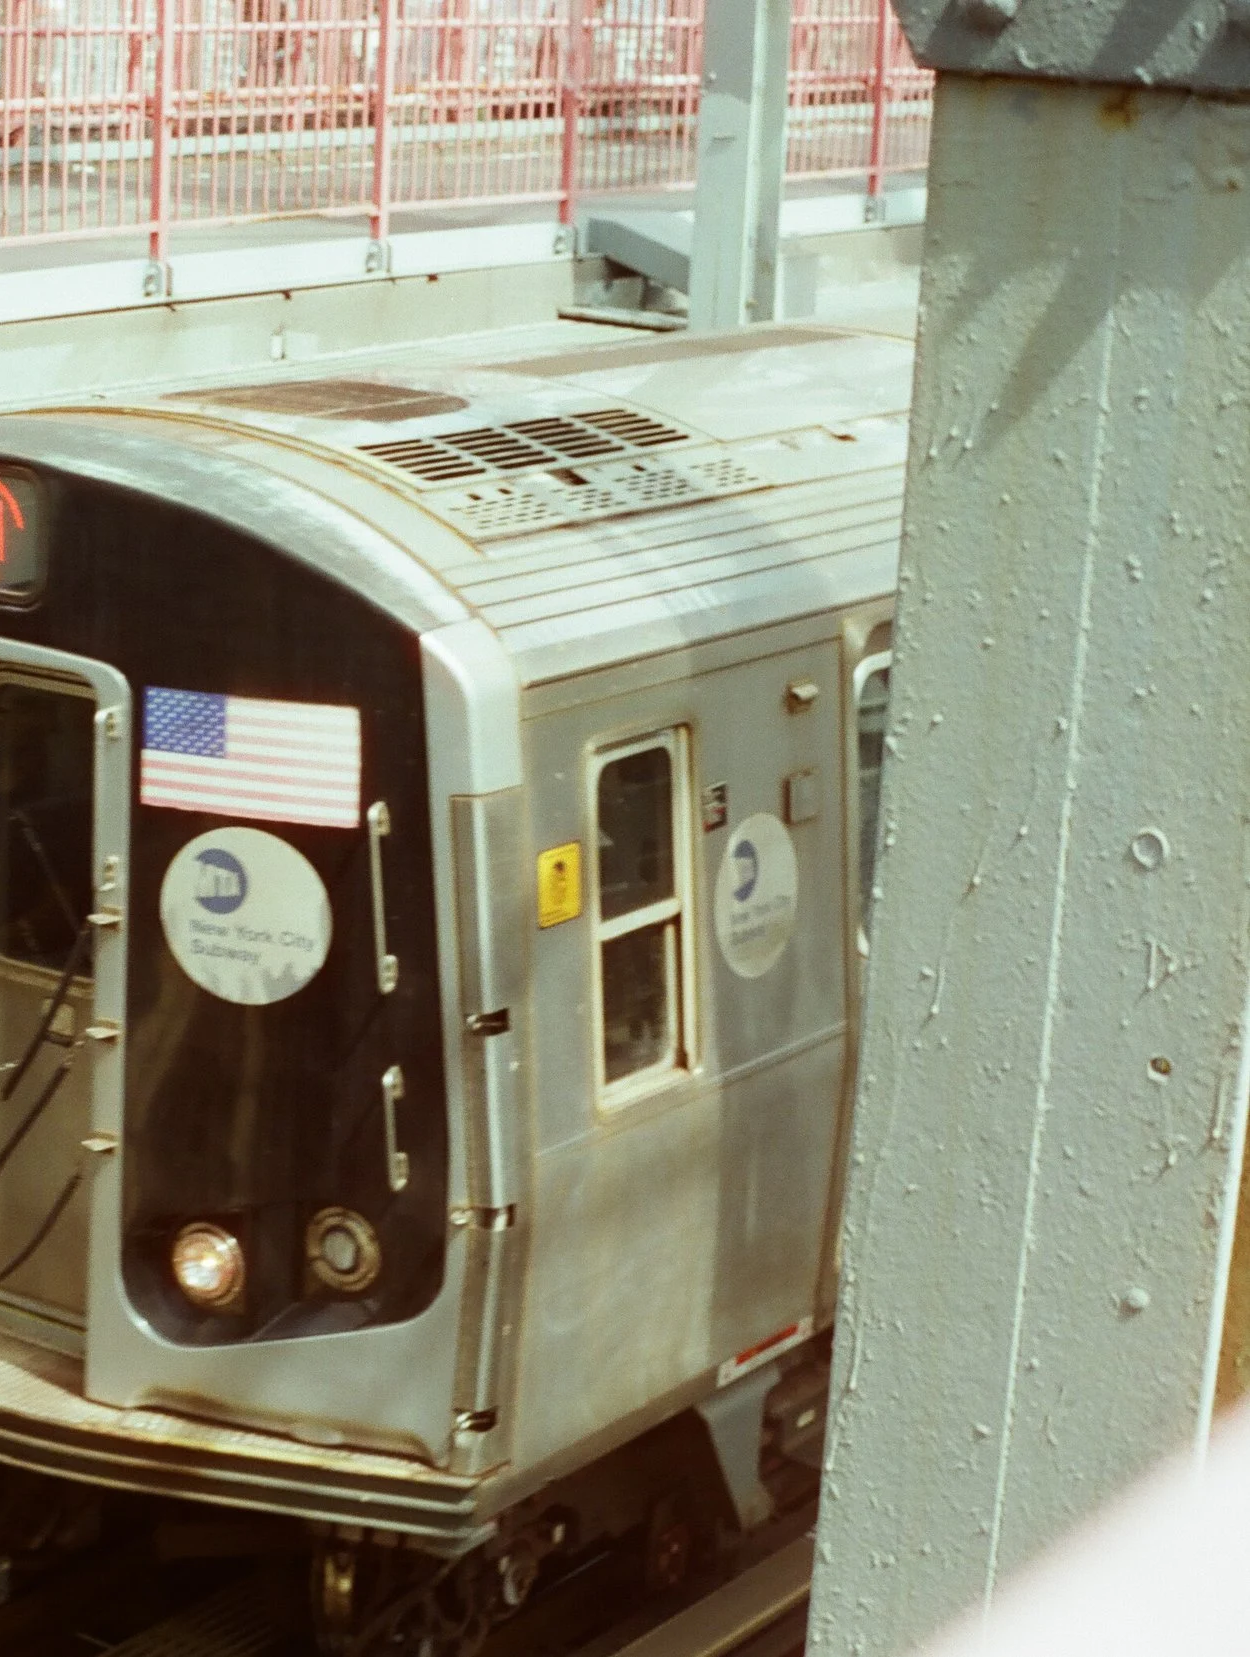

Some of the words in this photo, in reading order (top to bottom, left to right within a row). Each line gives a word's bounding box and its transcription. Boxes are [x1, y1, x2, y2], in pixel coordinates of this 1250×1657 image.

[189, 918, 230, 937] New
[235, 925, 274, 944] York
[279, 931, 315, 953] City
[189, 938, 261, 966] Subway
